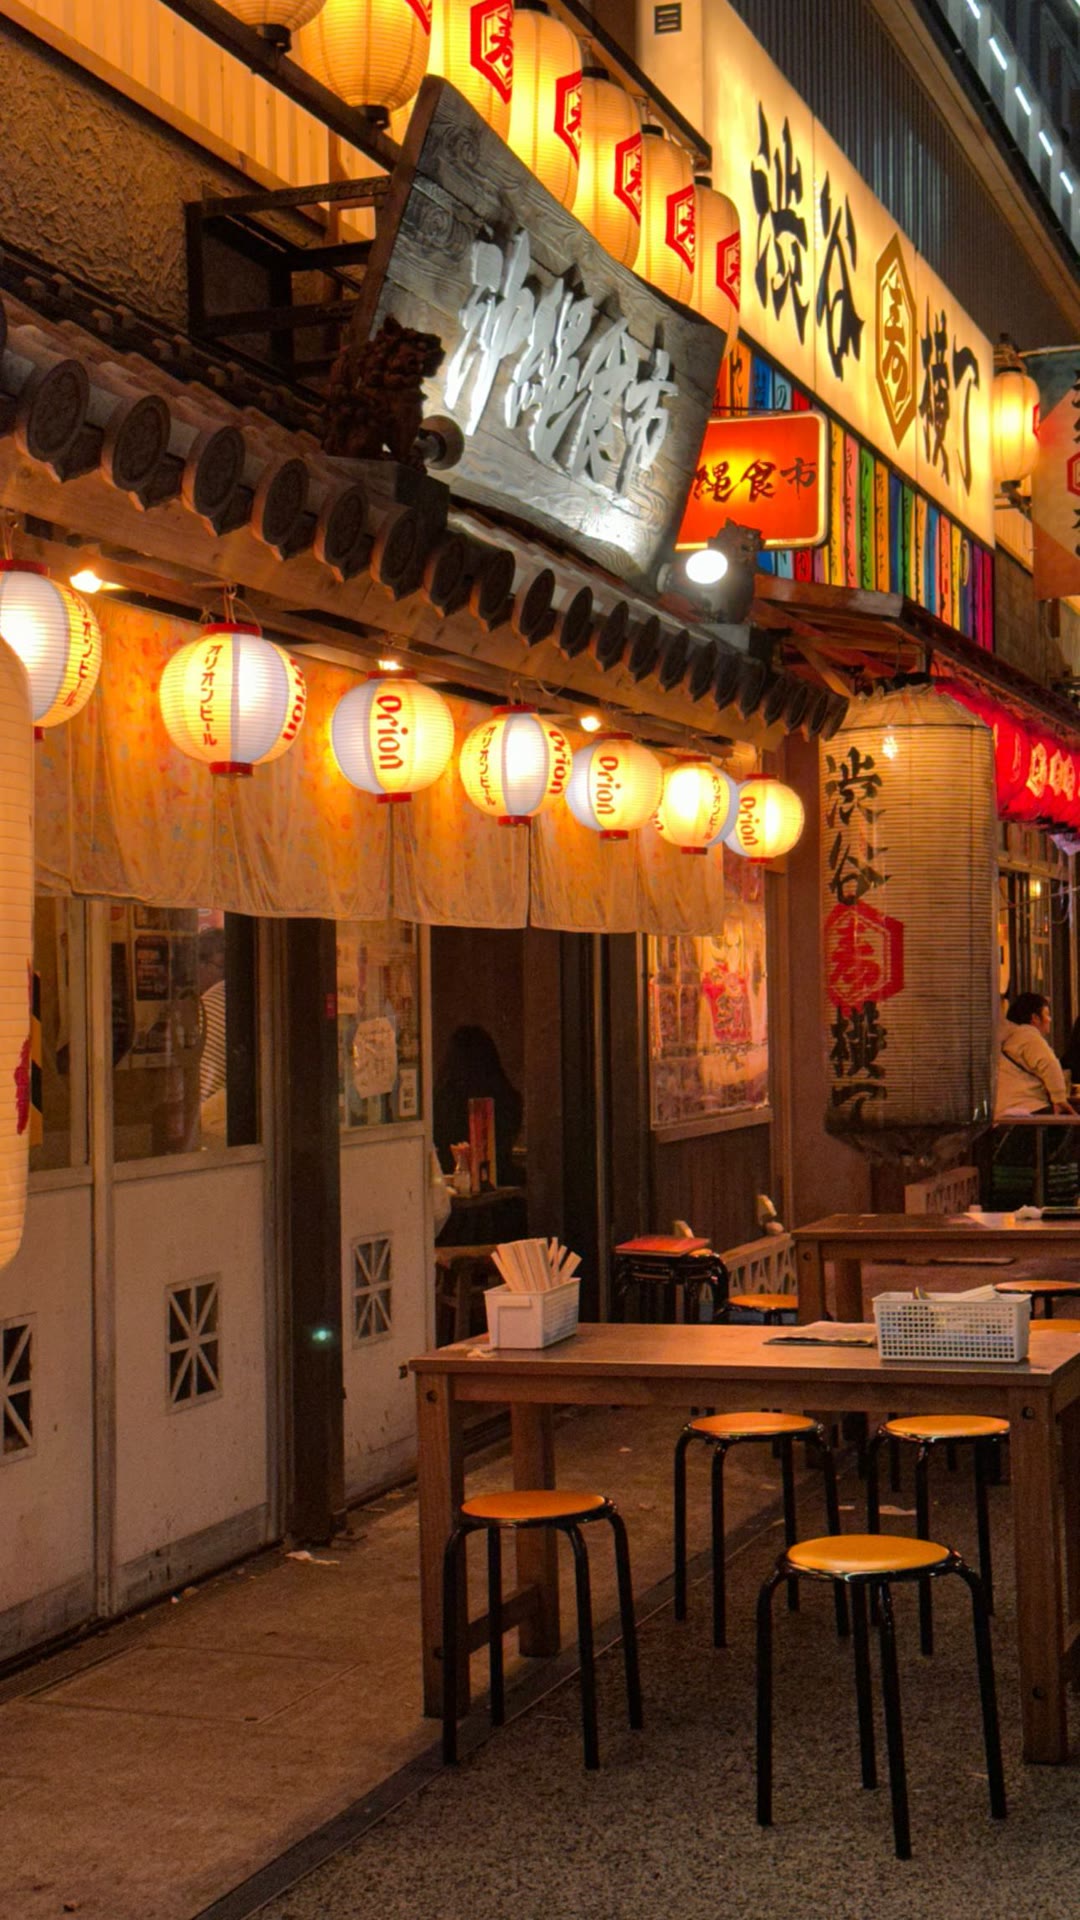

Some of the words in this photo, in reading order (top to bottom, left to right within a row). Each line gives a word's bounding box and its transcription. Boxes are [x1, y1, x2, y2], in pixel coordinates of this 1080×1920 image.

[751, 100, 866, 382] 渋谷
[919, 296, 980, 497] 横丁
[200, 644, 223, 747] オリオンビール
[376, 695, 409, 770] Orion
[479, 725, 498, 807] オリオンビール
[549, 730, 571, 795] Orion
[595, 755, 622, 815] Orion
[738, 796, 760, 847] Orion
